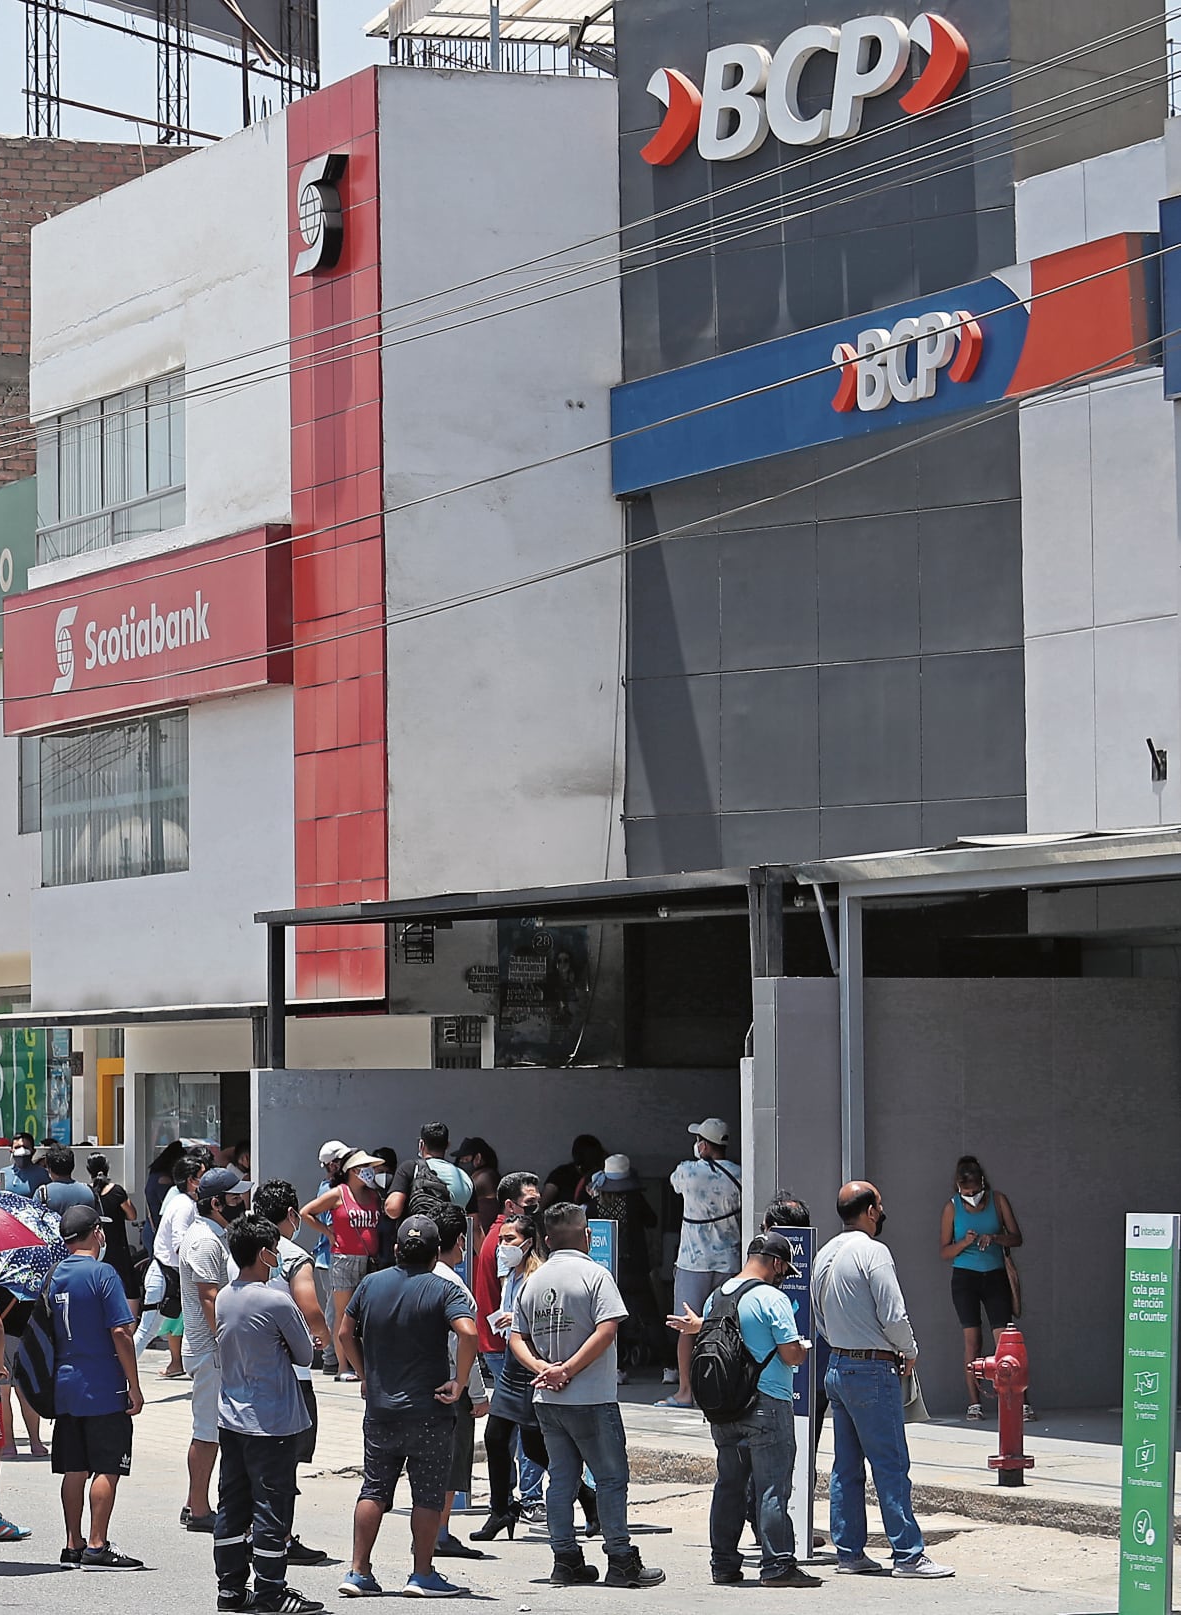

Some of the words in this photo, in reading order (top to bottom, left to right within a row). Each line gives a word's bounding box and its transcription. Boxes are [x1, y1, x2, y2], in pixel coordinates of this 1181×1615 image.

[698, 15, 910, 162] BCP
[857, 312, 955, 411] BCP
[85, 590, 210, 670] Scotiabank
[1141, 1227, 1166, 1237] Interbank
[591, 1236, 607, 1248] BBVA
[792, 1243, 804, 1256] VA
[1130, 1271, 1150, 1282] Estás
[1151, 1273, 1160, 1282] en
[1161, 1271, 1168, 1282] la
[1132, 1285, 1148, 1295] cola
[1148, 1287, 1165, 1298] para
[1133, 1297, 1164, 1308] atención
[1129, 1312, 1138, 1321] en
[1139, 1310, 1168, 1322] Counter
[1127, 1476, 1163, 1488] Transferencias
